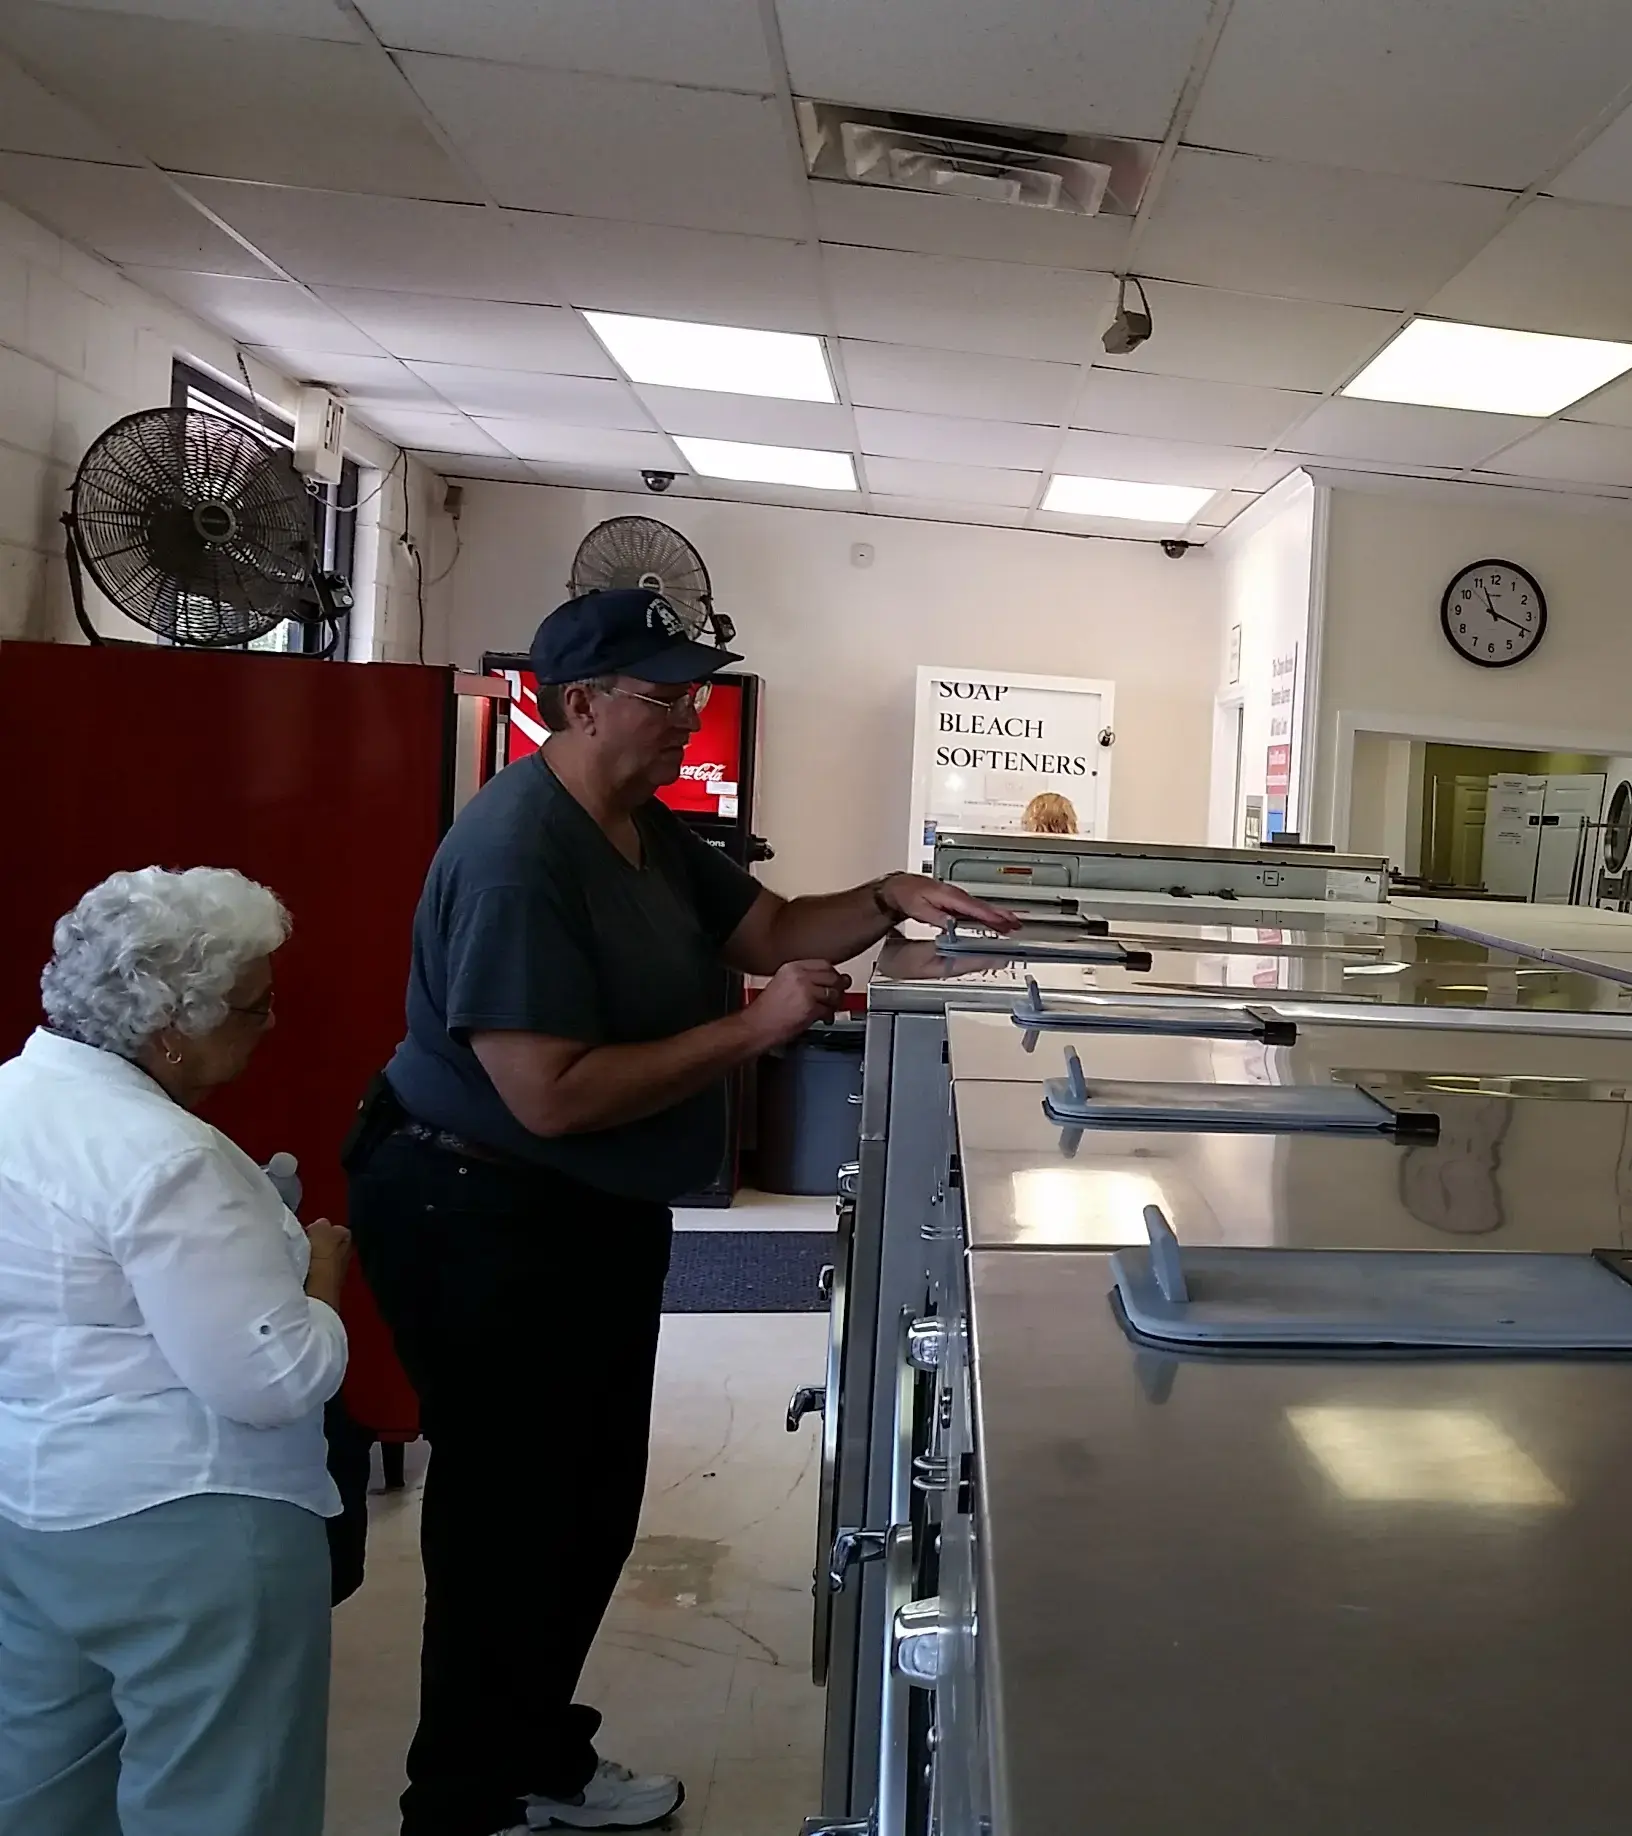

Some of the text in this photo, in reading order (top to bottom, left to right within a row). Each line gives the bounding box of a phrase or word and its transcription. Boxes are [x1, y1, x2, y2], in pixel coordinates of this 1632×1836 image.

[1474, 578, 1483, 588] 11
[1490, 574, 1501, 585] 12
[1511, 582, 1516, 591] 1
[1461, 589, 1472, 600] 10
[1520, 595, 1528, 605] 2
[1455, 605, 1462, 615] 9
[1525, 611, 1532, 621] 3
[1459, 623, 1466, 634] 8
[1518, 629, 1525, 639] 4
[1472, 636, 1478, 646] 7
[1506, 640, 1513, 649] 5
[1488, 643, 1495, 653] 6
[939, 681, 1009, 701] SOAP
[939, 712, 1044, 739] BLEACH
